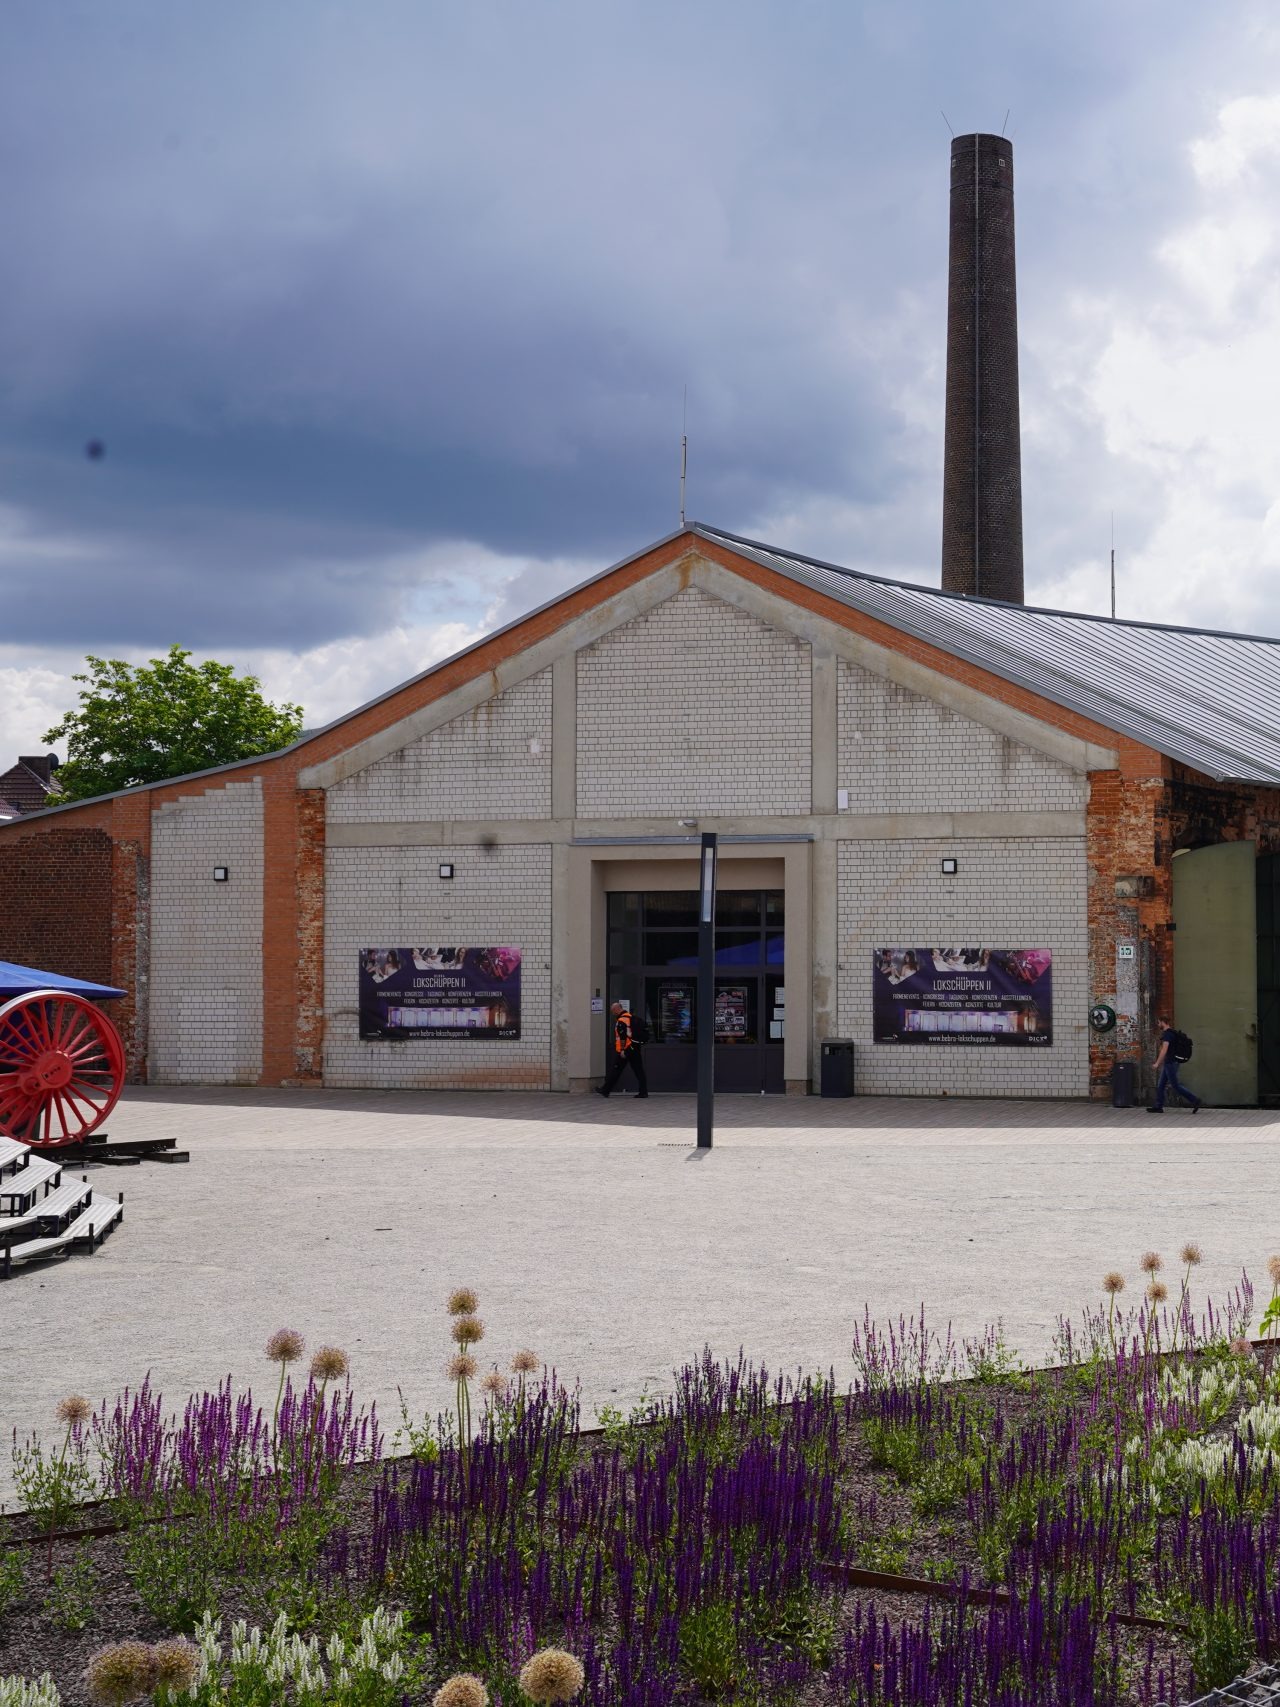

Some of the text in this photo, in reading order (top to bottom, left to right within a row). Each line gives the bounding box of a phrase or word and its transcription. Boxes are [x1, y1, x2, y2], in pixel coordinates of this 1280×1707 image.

[461, 978, 466, 988] II
[933, 980, 991, 991] LOKSCHUPPEN II
